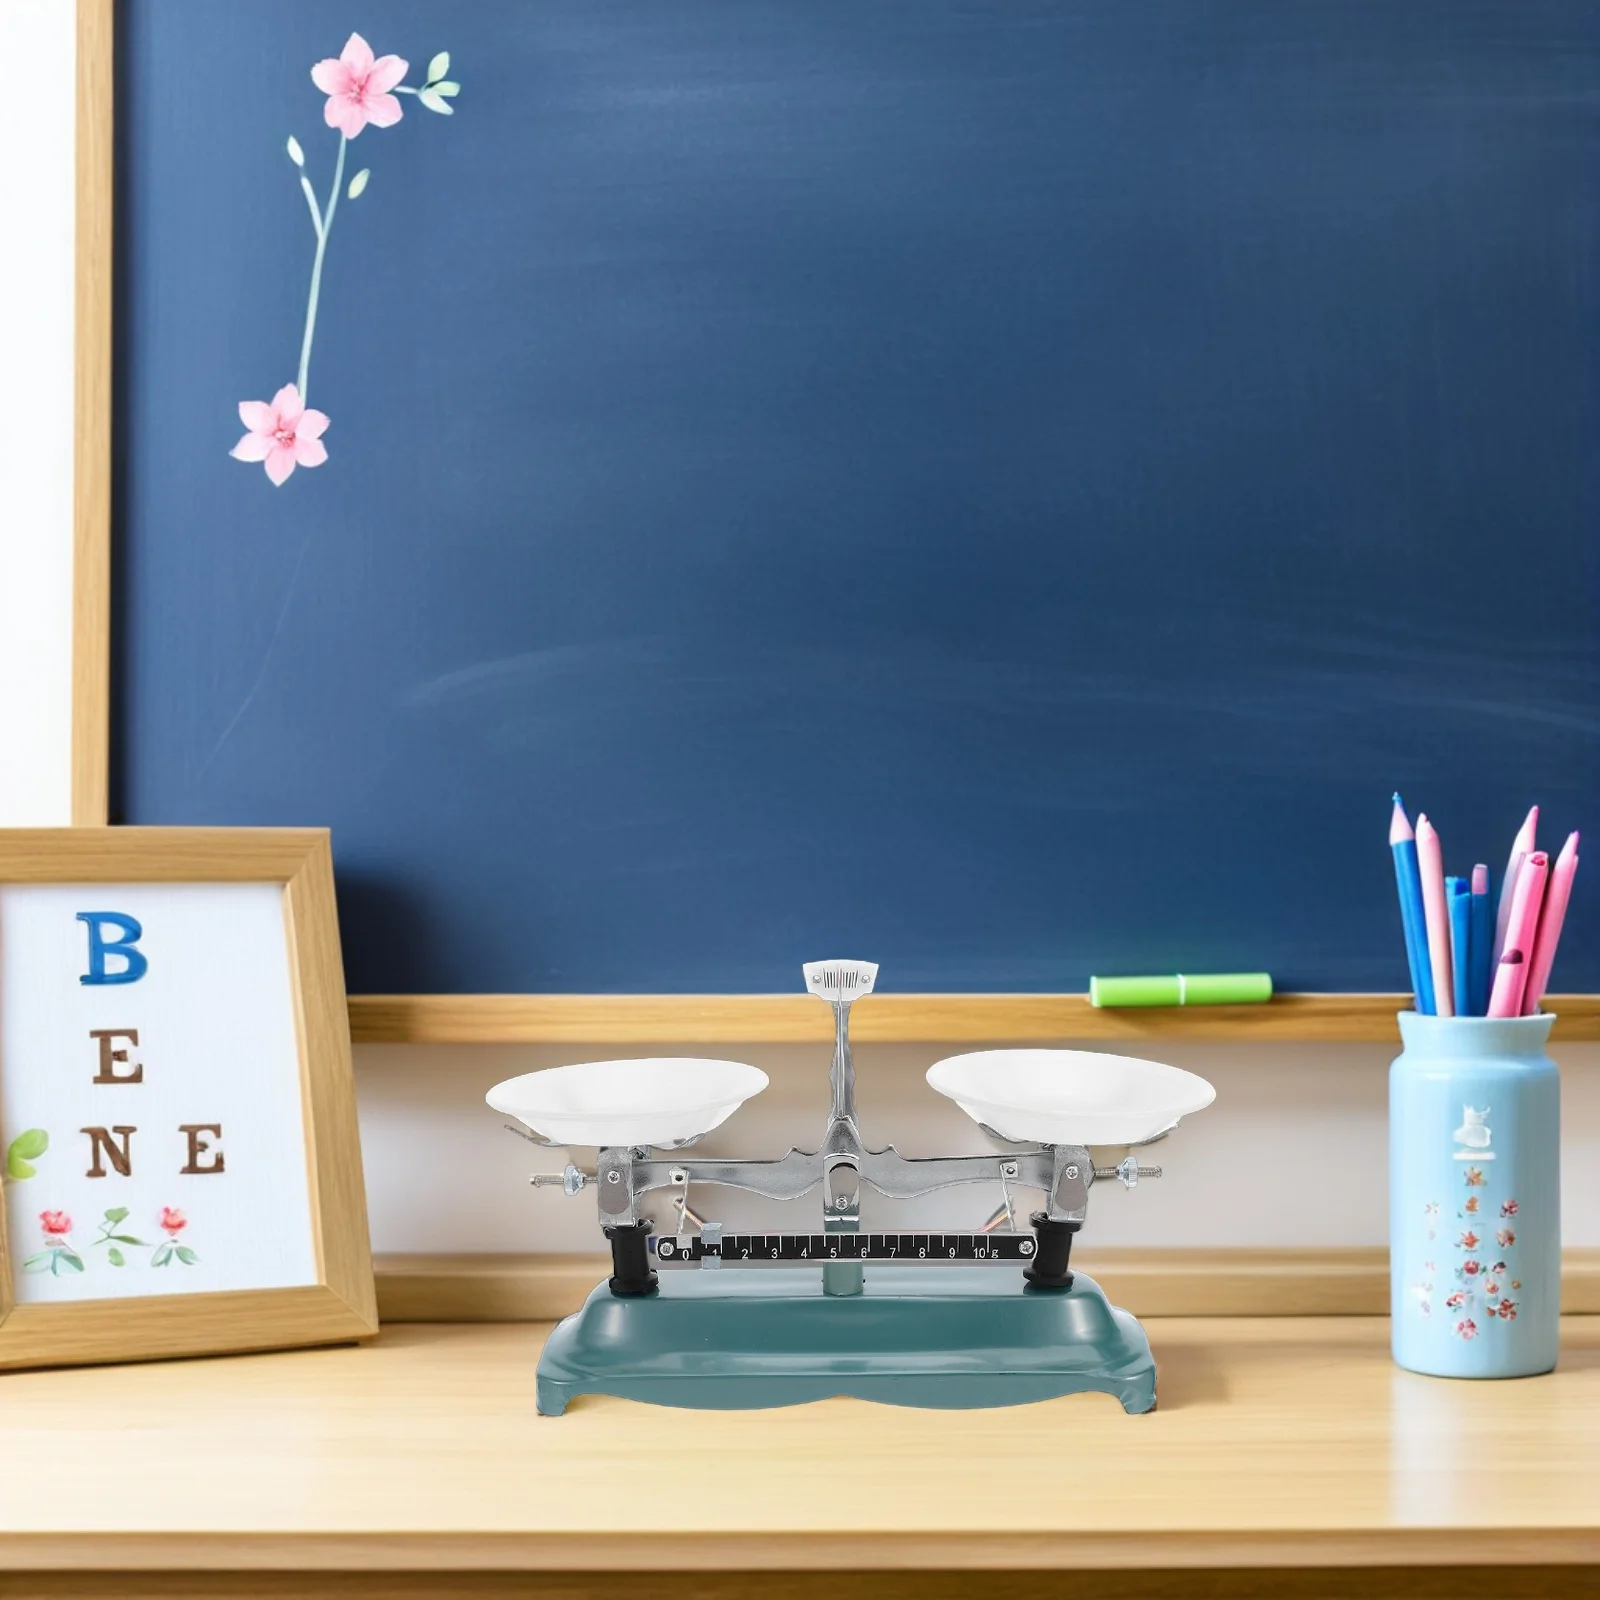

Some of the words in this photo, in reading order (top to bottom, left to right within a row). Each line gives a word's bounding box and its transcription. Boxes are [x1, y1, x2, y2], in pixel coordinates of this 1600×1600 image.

[682, 1249, 690, 1261] 0
[741, 1248, 749, 1259] 2
[771, 1247, 778, 1259] 3
[800, 1247, 808, 1258] 4
[830, 1247, 837, 1258] 5
[860, 1247, 867, 1258] 6
[889, 1247, 897, 1258] 7
[918, 1247, 926, 1258] 8
[948, 1247, 956, 1258] 9
[973, 1247, 986, 1259] 10
